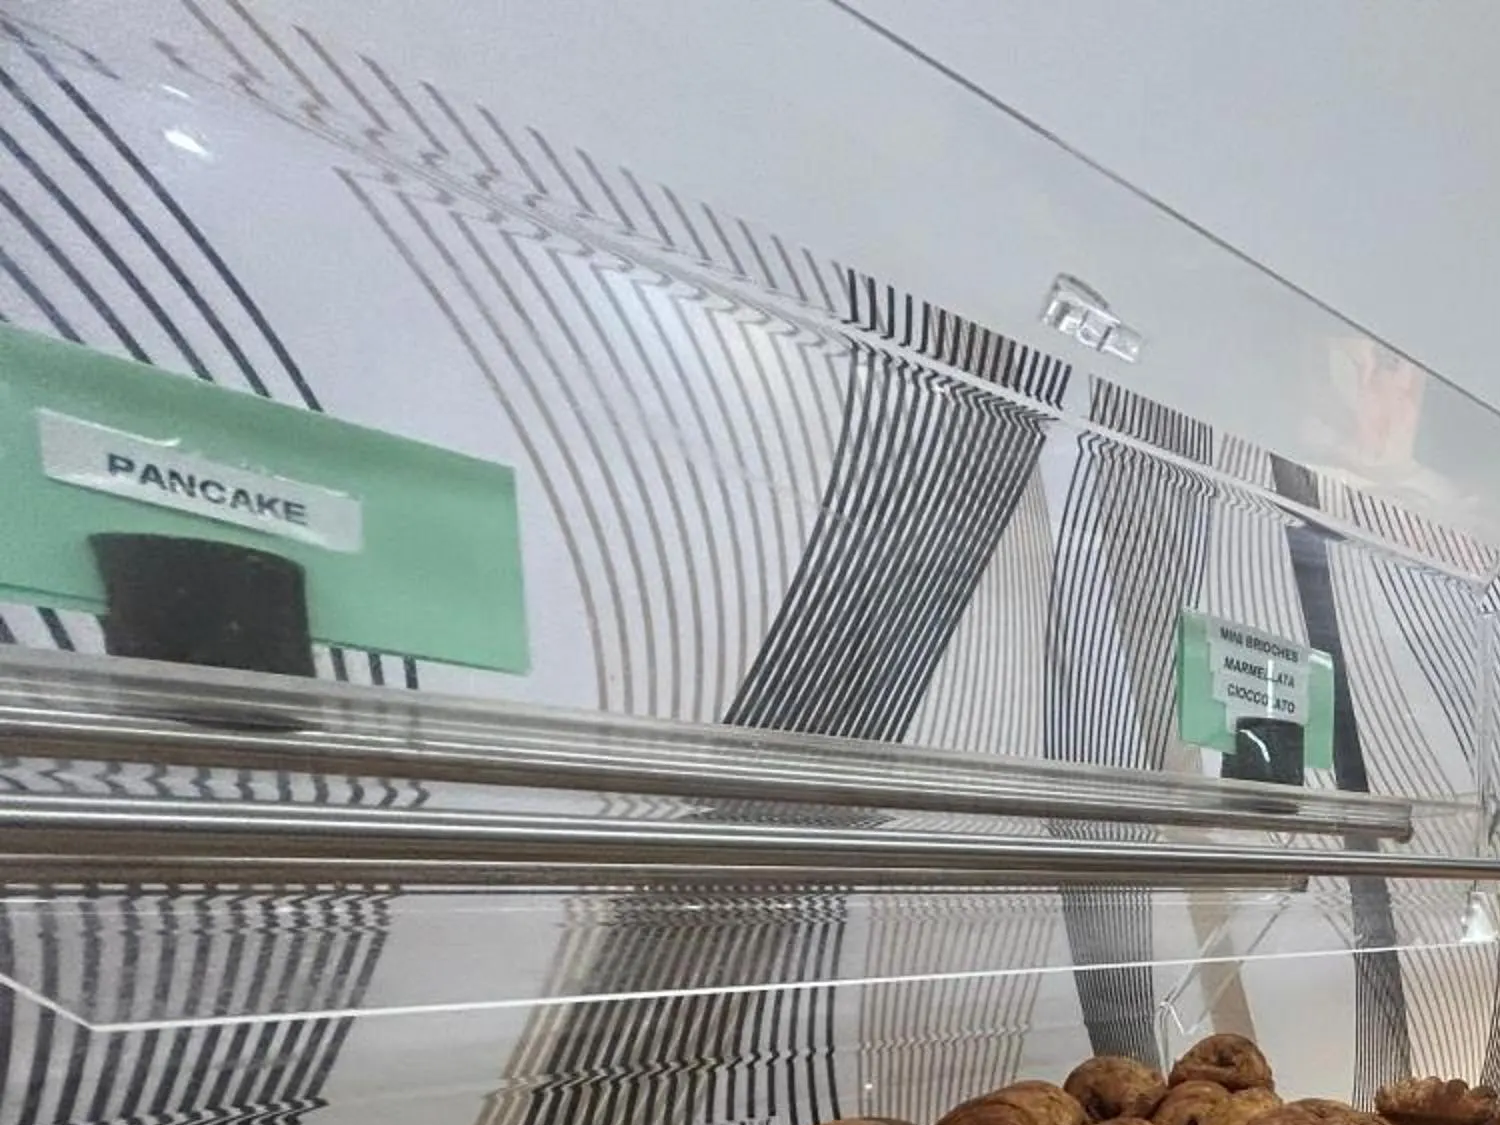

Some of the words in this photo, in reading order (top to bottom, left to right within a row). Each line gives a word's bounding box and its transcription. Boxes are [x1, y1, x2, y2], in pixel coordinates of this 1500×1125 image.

[107, 453, 308, 526] PANCAKE
[1245, 635, 1298, 663] BRIOCHES
[1227, 683, 1296, 713] CIOCCOATO
